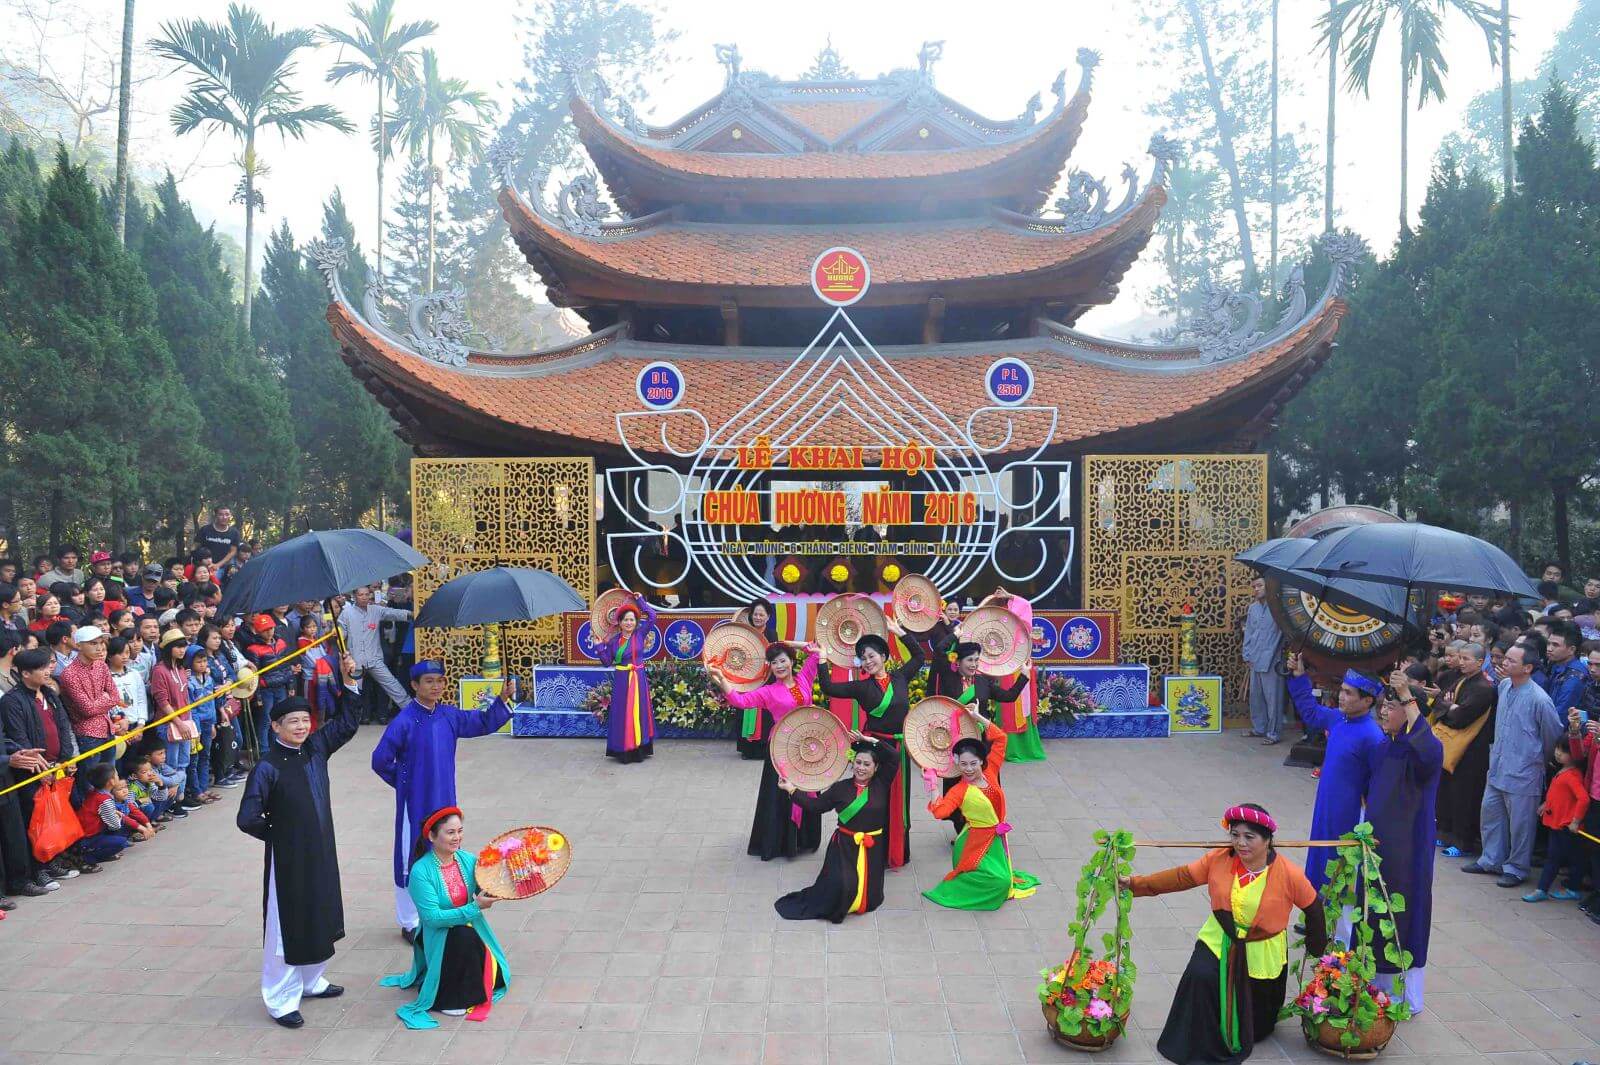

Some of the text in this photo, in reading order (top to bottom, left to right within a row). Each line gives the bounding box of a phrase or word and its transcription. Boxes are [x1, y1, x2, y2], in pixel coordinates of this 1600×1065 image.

[647, 387, 674, 400] 2016
[996, 383, 1023, 396] 2560
[737, 435, 937, 476] LỄ KHAI HỘI
[703, 484, 977, 526] CHÙA HƯƠNG NĂM 2016
[789, 542, 798, 555] 6
[800, 539, 834, 556] THÁNG
[839, 539, 870, 556] GIÊNG
[873, 539, 899, 556] NĂM
[934, 539, 961, 556] THÂN
